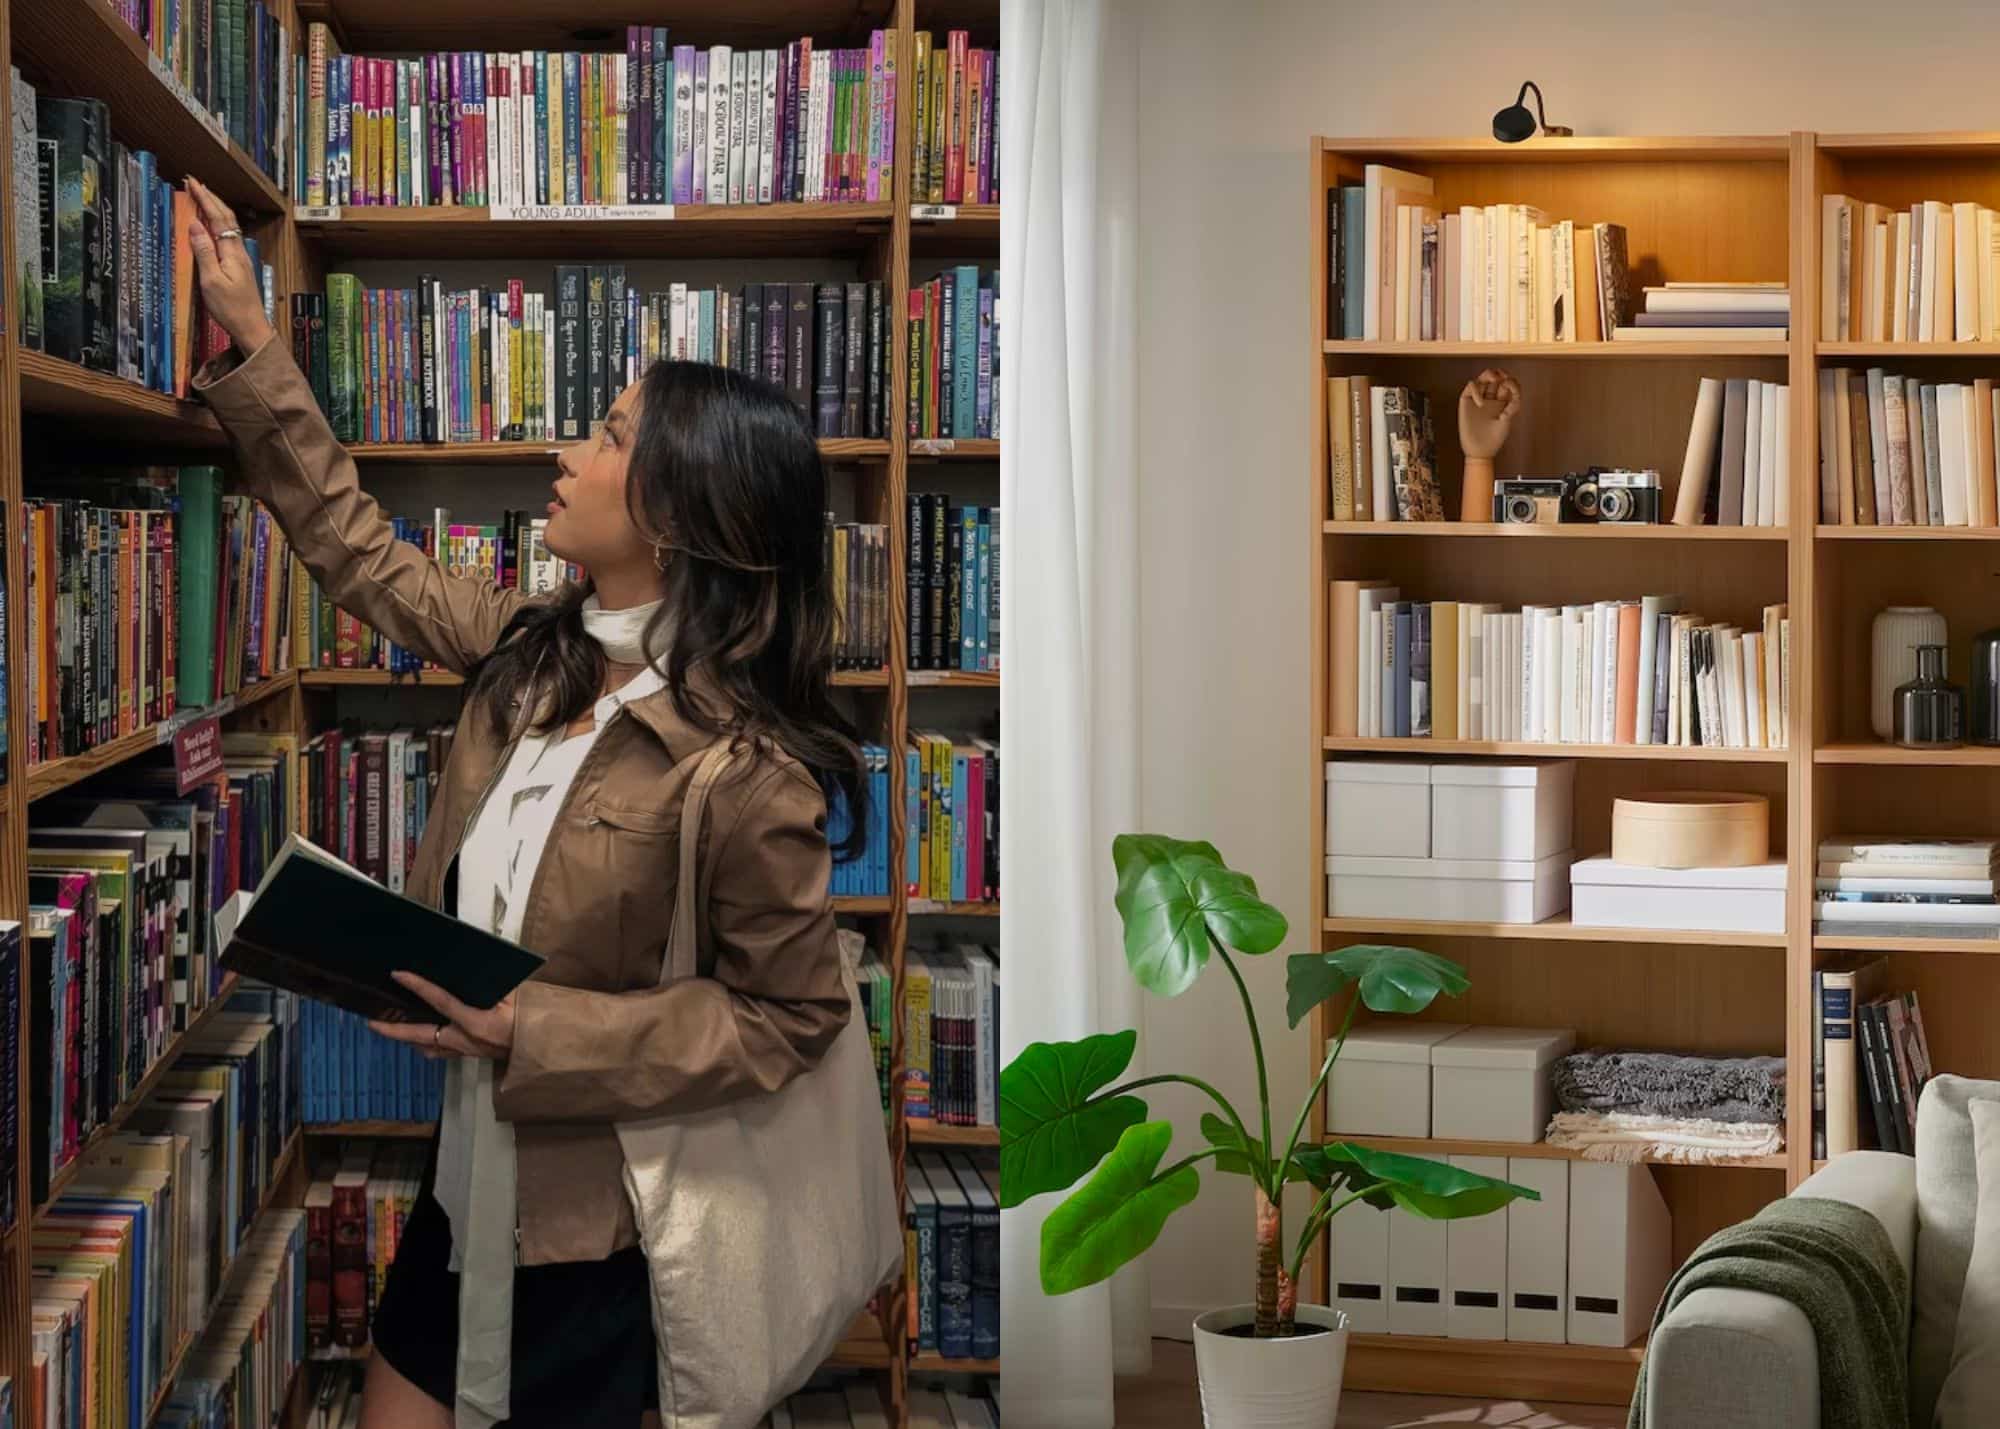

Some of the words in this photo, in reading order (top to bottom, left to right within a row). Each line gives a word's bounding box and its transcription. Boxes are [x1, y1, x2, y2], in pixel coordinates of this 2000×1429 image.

[328, 108, 337, 142] Matilda
[339, 103, 349, 137] Matilda
[715, 100, 727, 139] SCHOOL
[747, 124, 757, 147] FEAR
[712, 145, 725, 176] FEAR
[510, 207, 560, 219] YOUNG
[564, 206, 608, 219] ADULT
[102, 196, 113, 278] AIRMAN
[422, 321, 433, 356] SECRET
[423, 358, 435, 408] NOTEBOOK
[911, 506, 921, 543] MICHAEL
[934, 507, 945, 544] MICHAEL
[536, 563, 547, 577] The
[911, 545, 921, 562] VEY
[934, 545, 945, 561] VEY
[83, 671, 91, 724] COLLINS
[366, 772, 380, 798] GREAT
[366, 799, 380, 860] EXPECTATIONS
